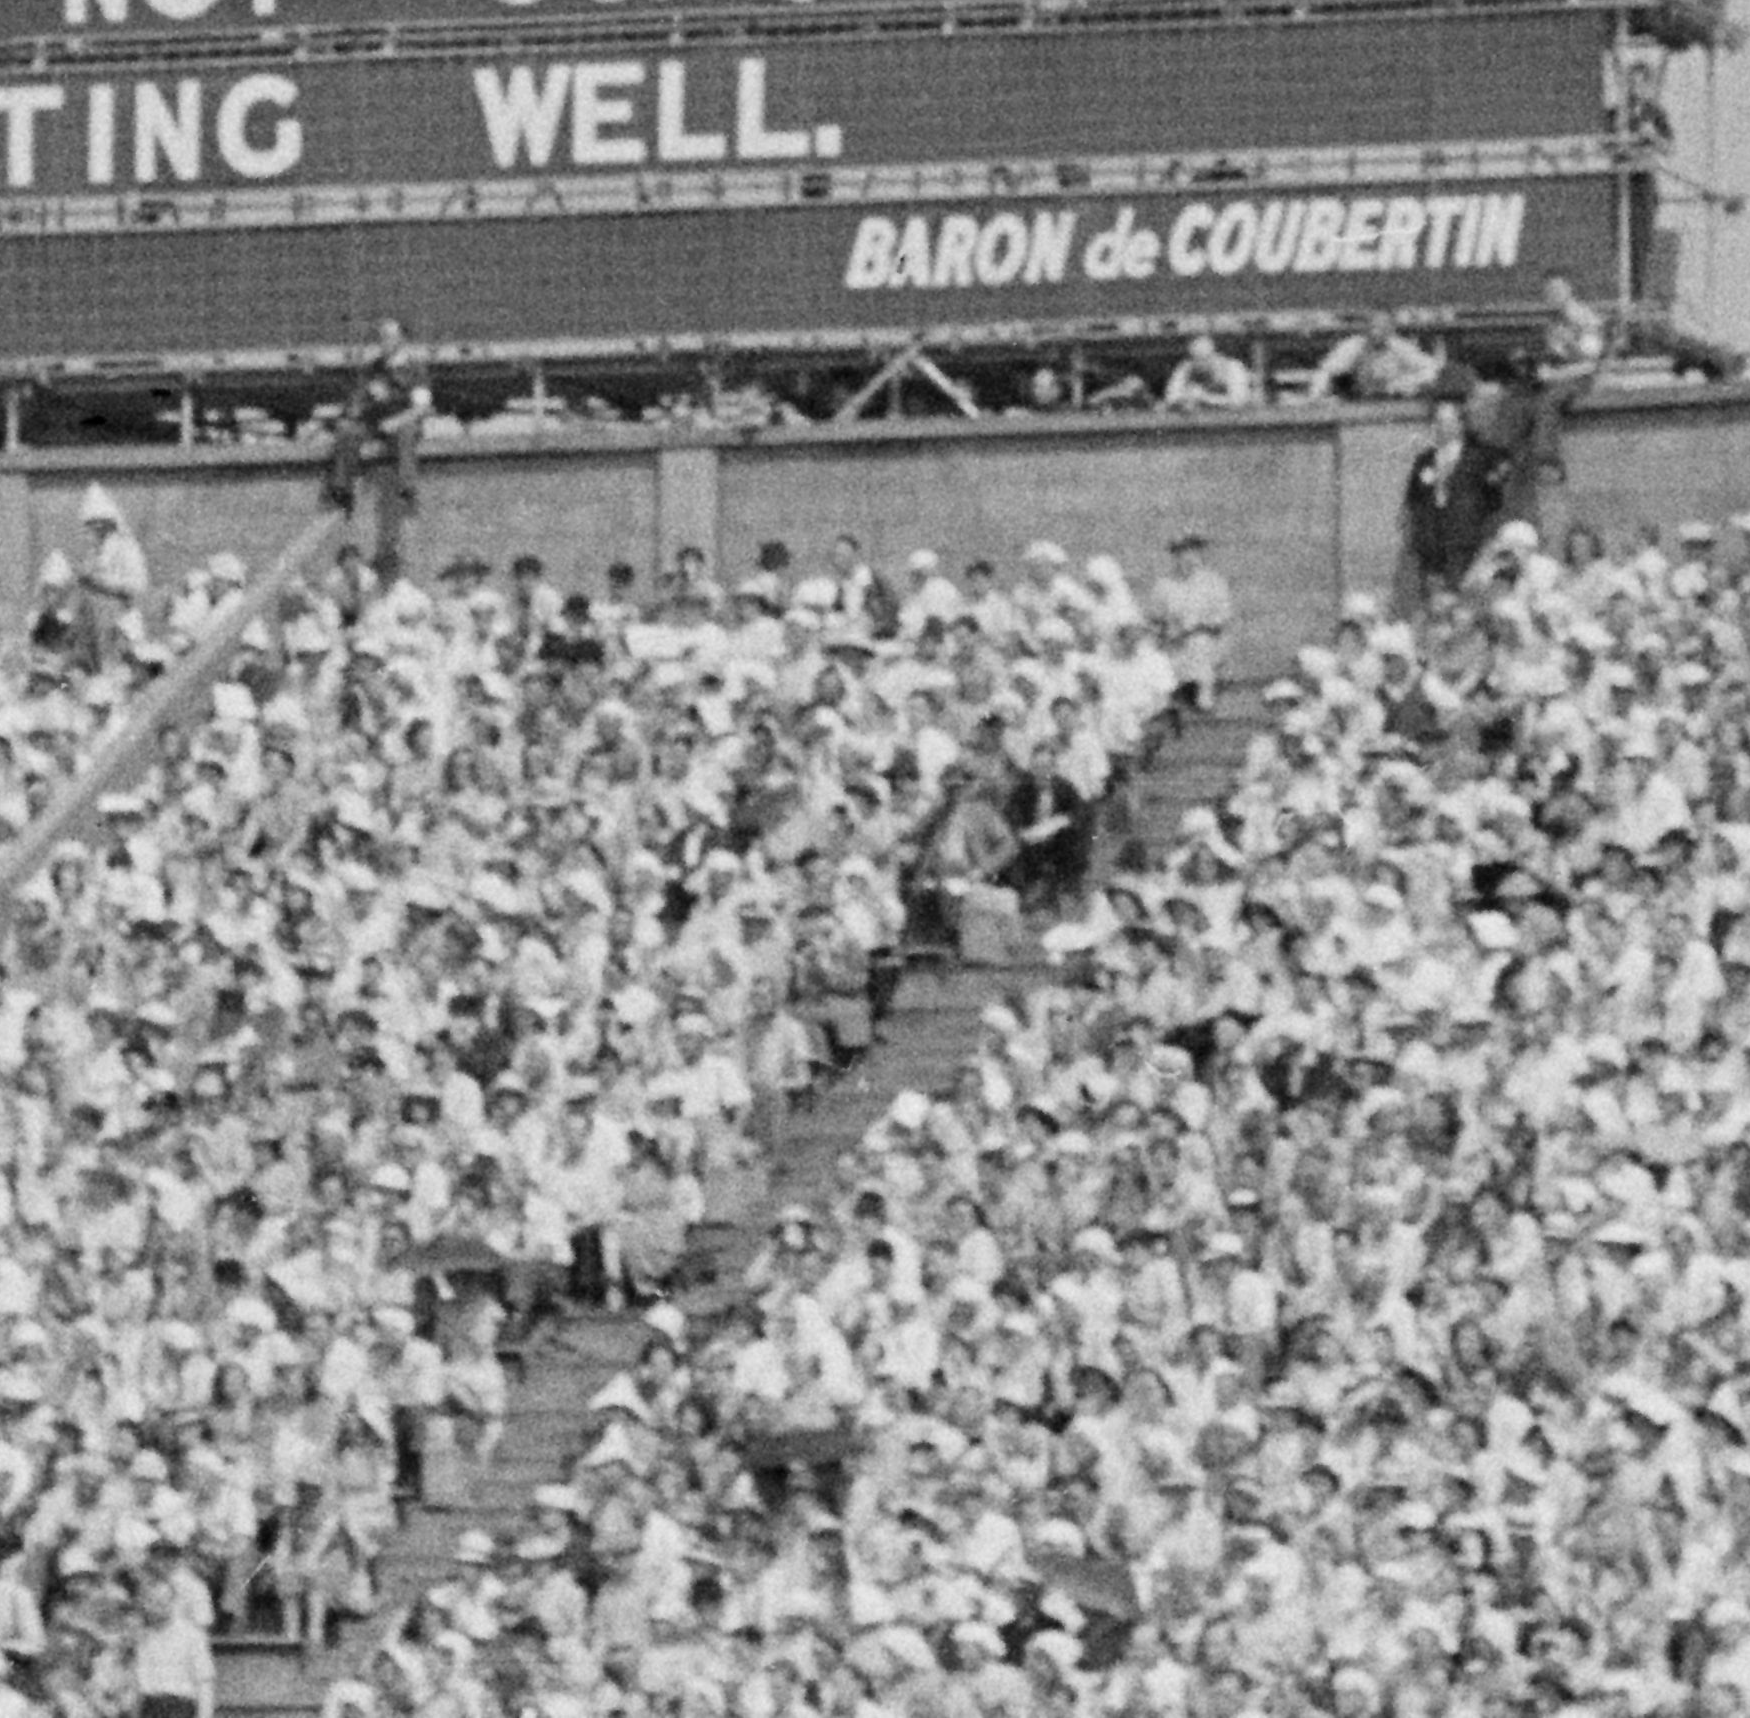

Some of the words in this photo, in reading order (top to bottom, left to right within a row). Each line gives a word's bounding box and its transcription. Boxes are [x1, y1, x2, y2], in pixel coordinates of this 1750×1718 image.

[472, 56, 843, 169] WELL.
[844, 209, 1069, 289] BARON
[1083, 206, 1162, 281] de
[1166, 192, 1527, 277] COUBERTIN
